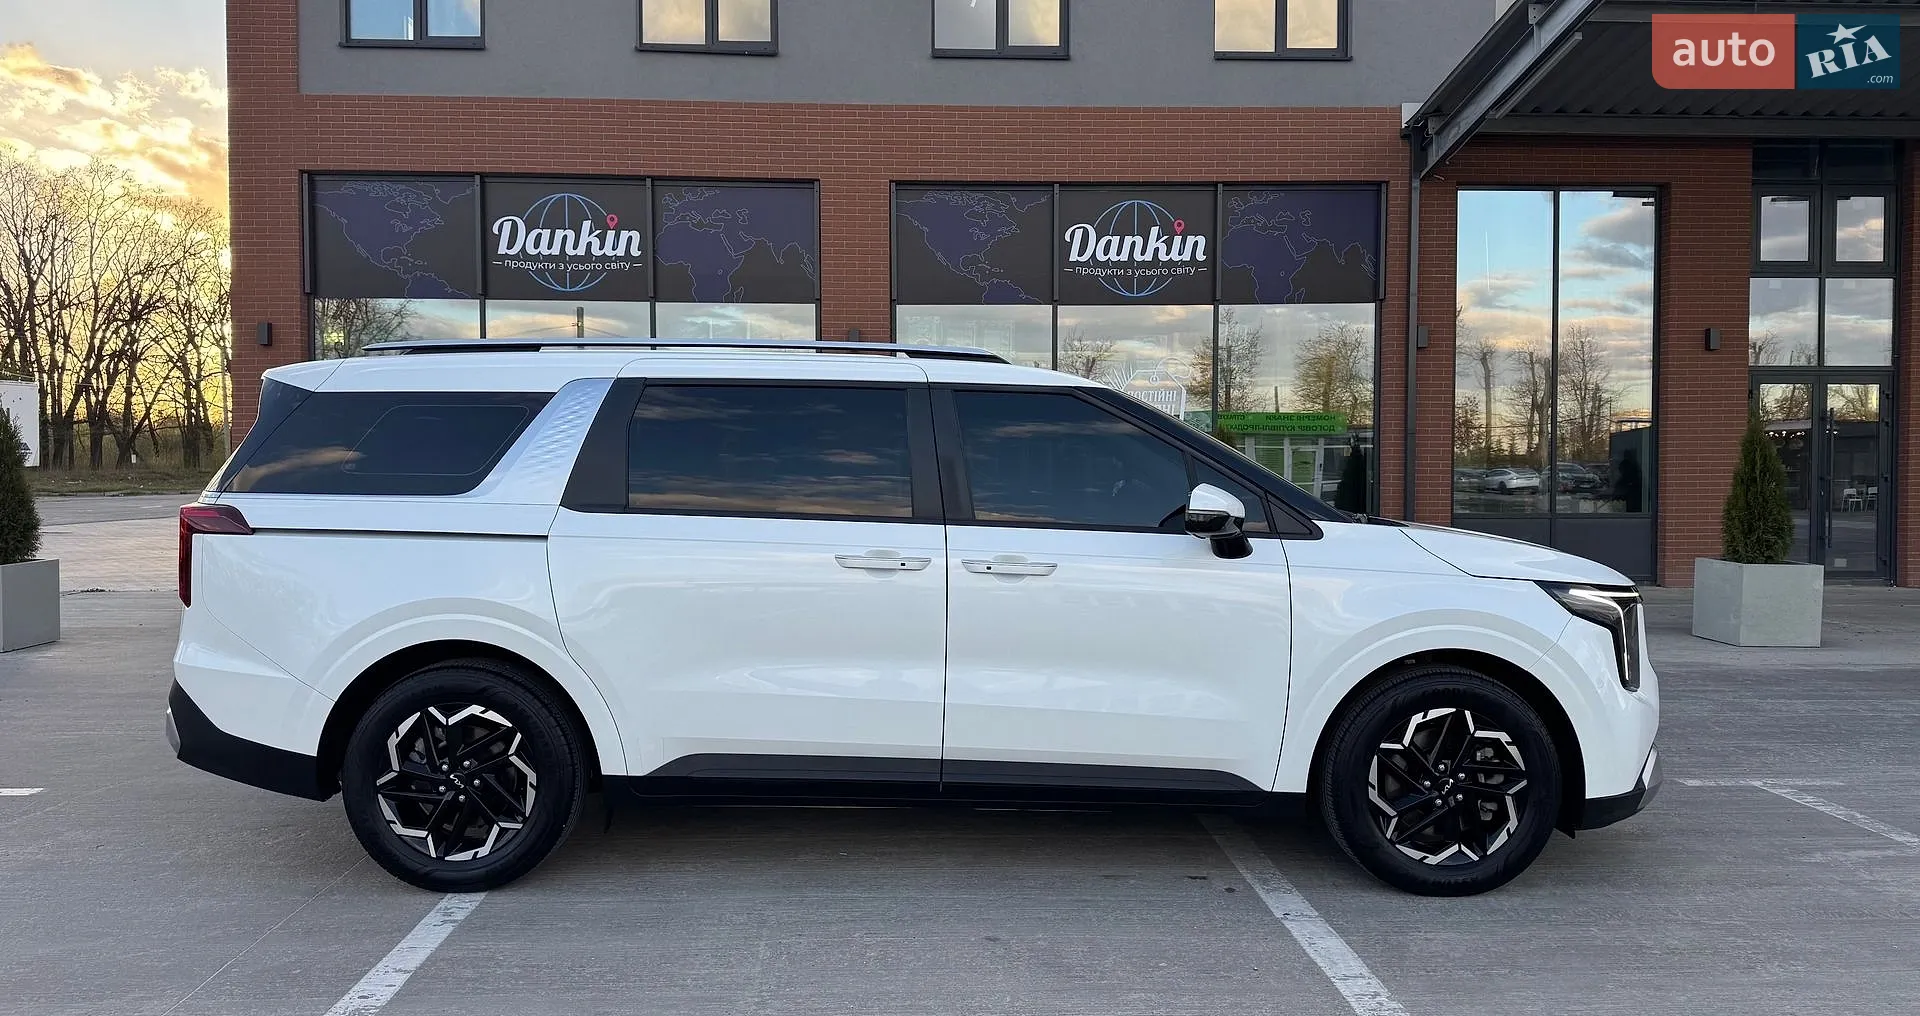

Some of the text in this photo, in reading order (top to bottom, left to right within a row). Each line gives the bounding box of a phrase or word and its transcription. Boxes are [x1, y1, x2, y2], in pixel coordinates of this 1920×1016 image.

[492, 215, 642, 257] Dankin
[1064, 222, 1207, 262] Dankin
[504, 260, 631, 271] продукти з усього світу
[1075, 265, 1196, 277] продукти з усього світу
